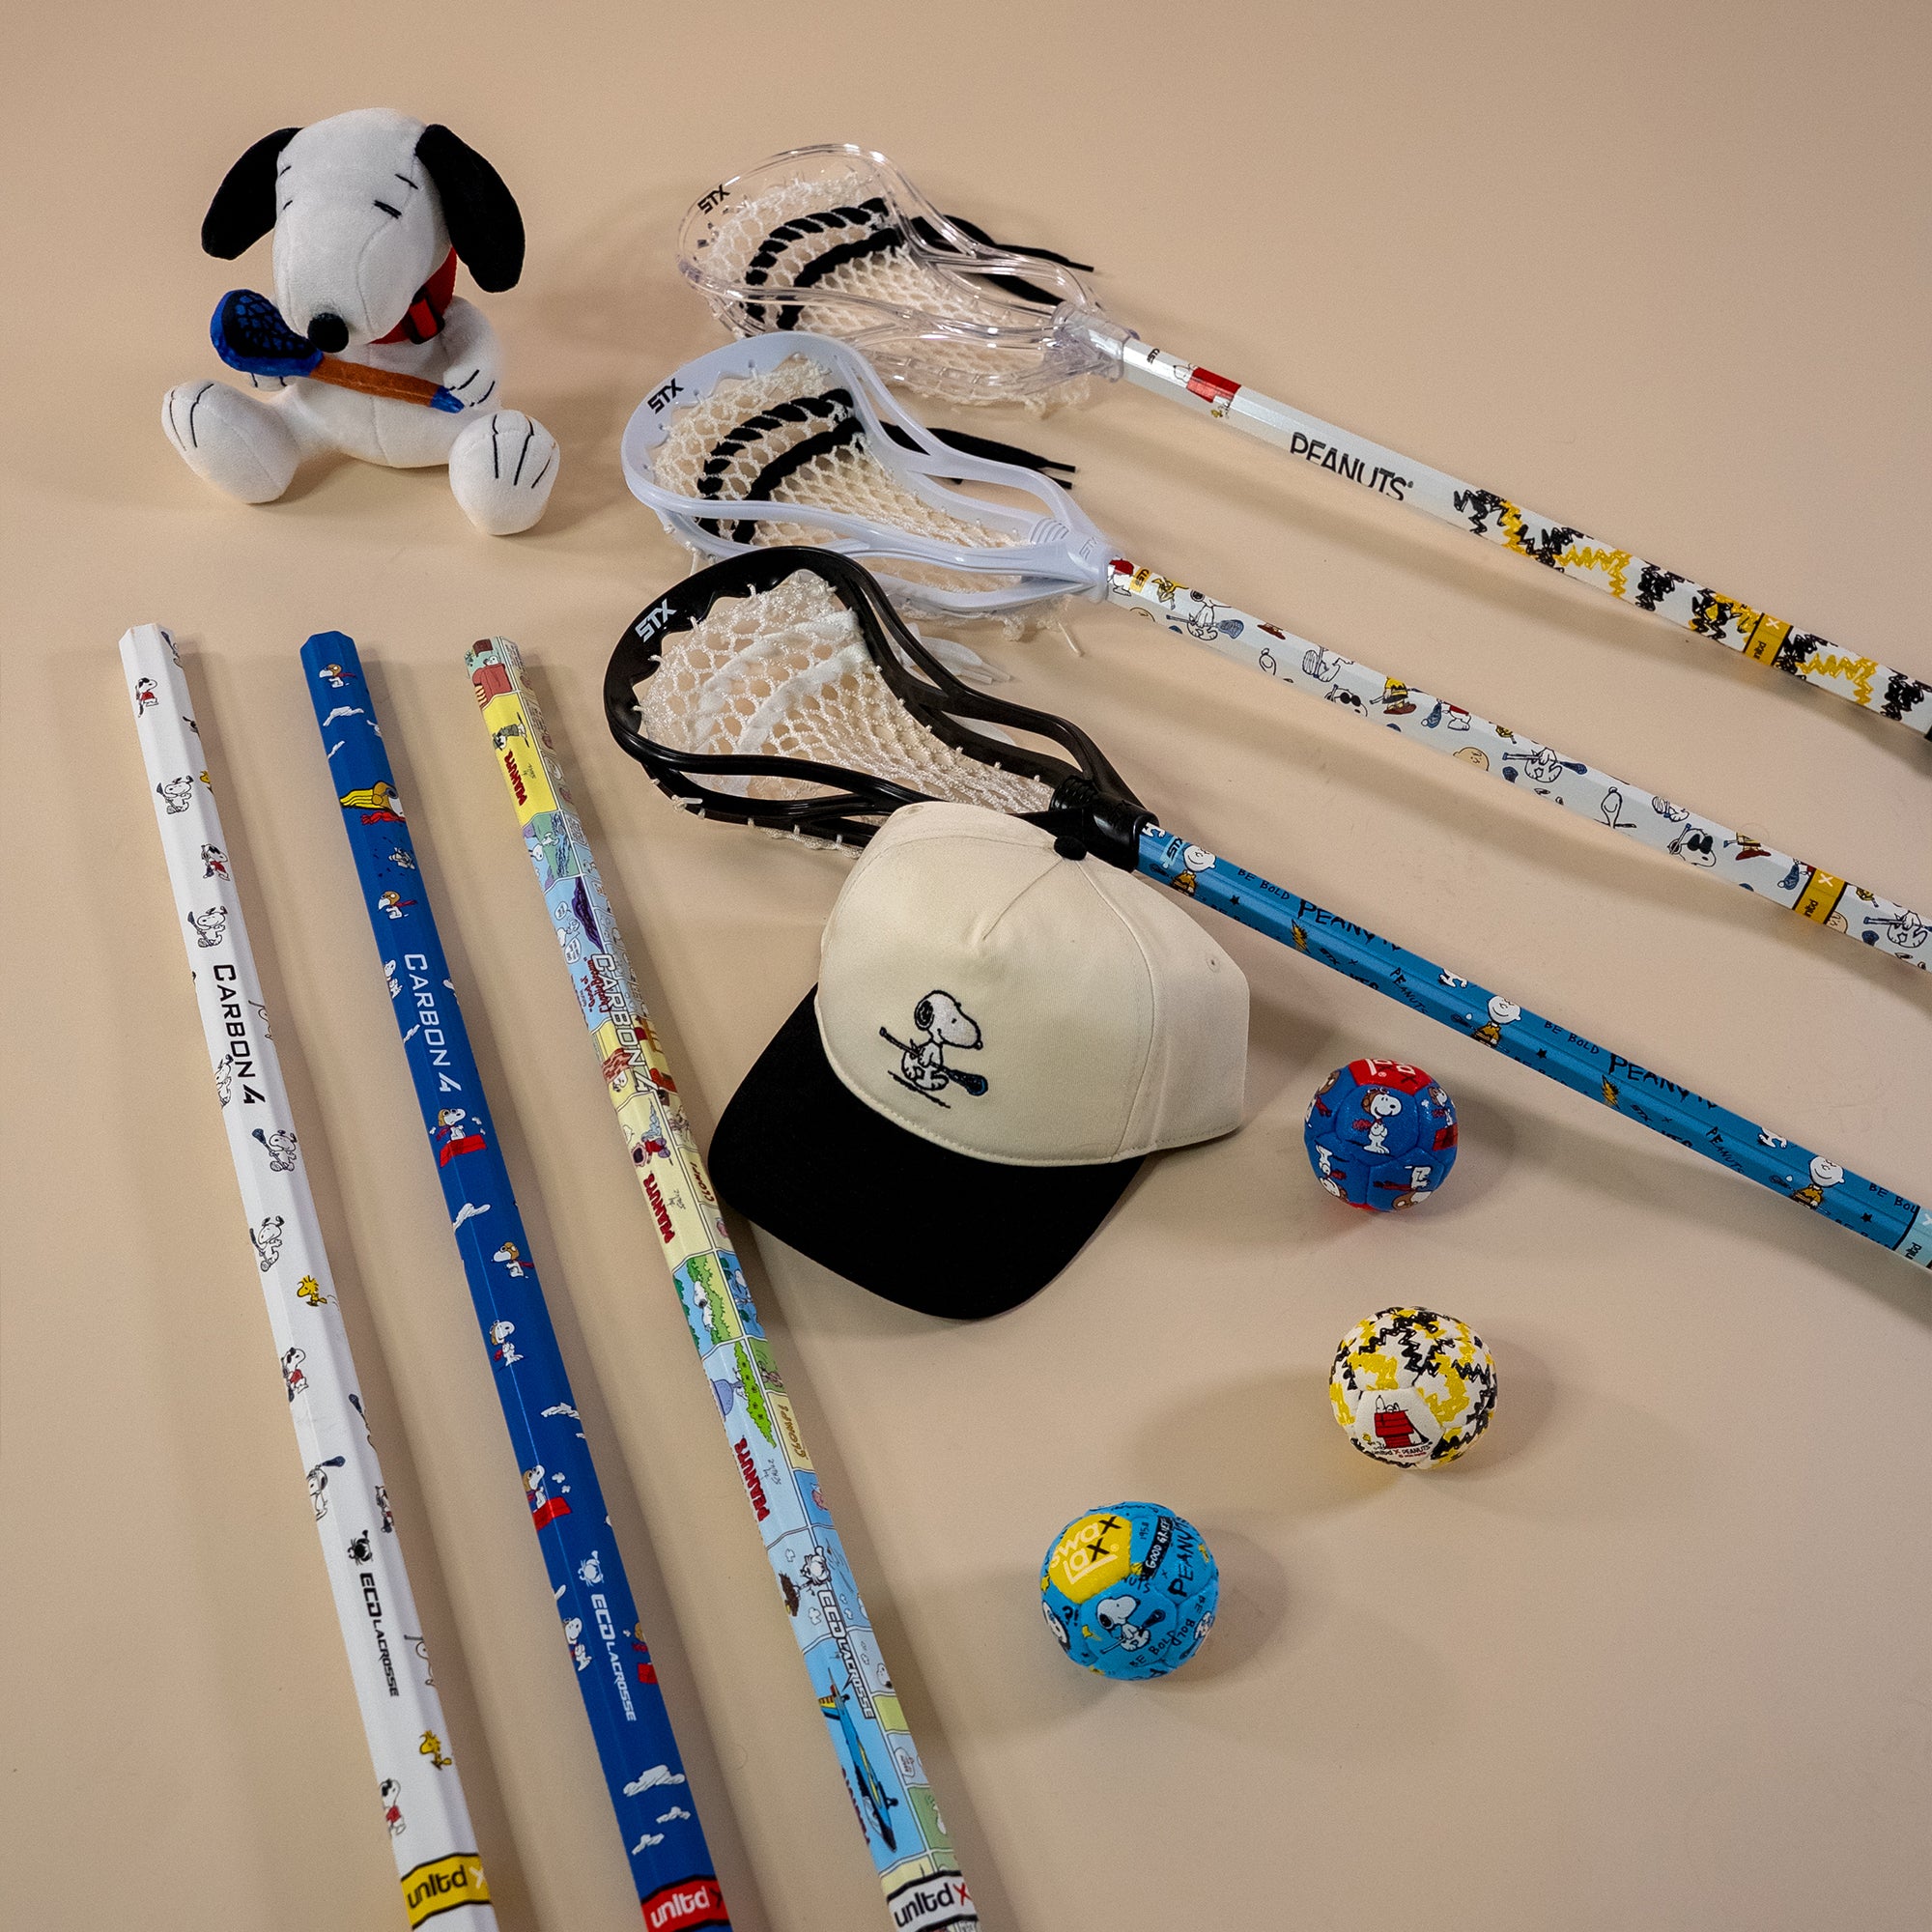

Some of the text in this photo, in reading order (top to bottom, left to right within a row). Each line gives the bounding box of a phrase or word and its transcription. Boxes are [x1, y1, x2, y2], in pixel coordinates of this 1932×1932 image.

[696, 184, 730, 214] STX
[647, 378, 684, 413] STX
[1290, 432, 1408, 501] PEANUTS
[634, 598, 678, 642] STX
[1237, 868, 1291, 900] BE BOLD
[1804, 898, 1819, 918] nltd
[404, 953, 451, 1066] CARBON
[590, 953, 645, 1066] CARBON
[1390, 967, 1429, 1014] PEANUTS
[213, 964, 256, 1078] CARBON
[1544, 1020, 1600, 1055] BE BOLD
[643, 1173, 675, 1244] PEANUTS
[1868, 1183, 1917, 1213] BE BOL
[1905, 1242, 1922, 1261] nltd
[1402, 1445, 1432, 1455] PEANUTS
[734, 1437, 770, 1522] PEANUTS
[1145, 1543, 1163, 1570] GOOD
[359, 1572, 400, 1697] ECD LACROSSE
[817, 1589, 877, 1719] ECD LACROSSE
[590, 1594, 638, 1722] ECD LACROSSE
[407, 1864, 468, 1910] unltd
[650, 1887, 711, 1929] unltd
[894, 1883, 955, 1928] unltd
